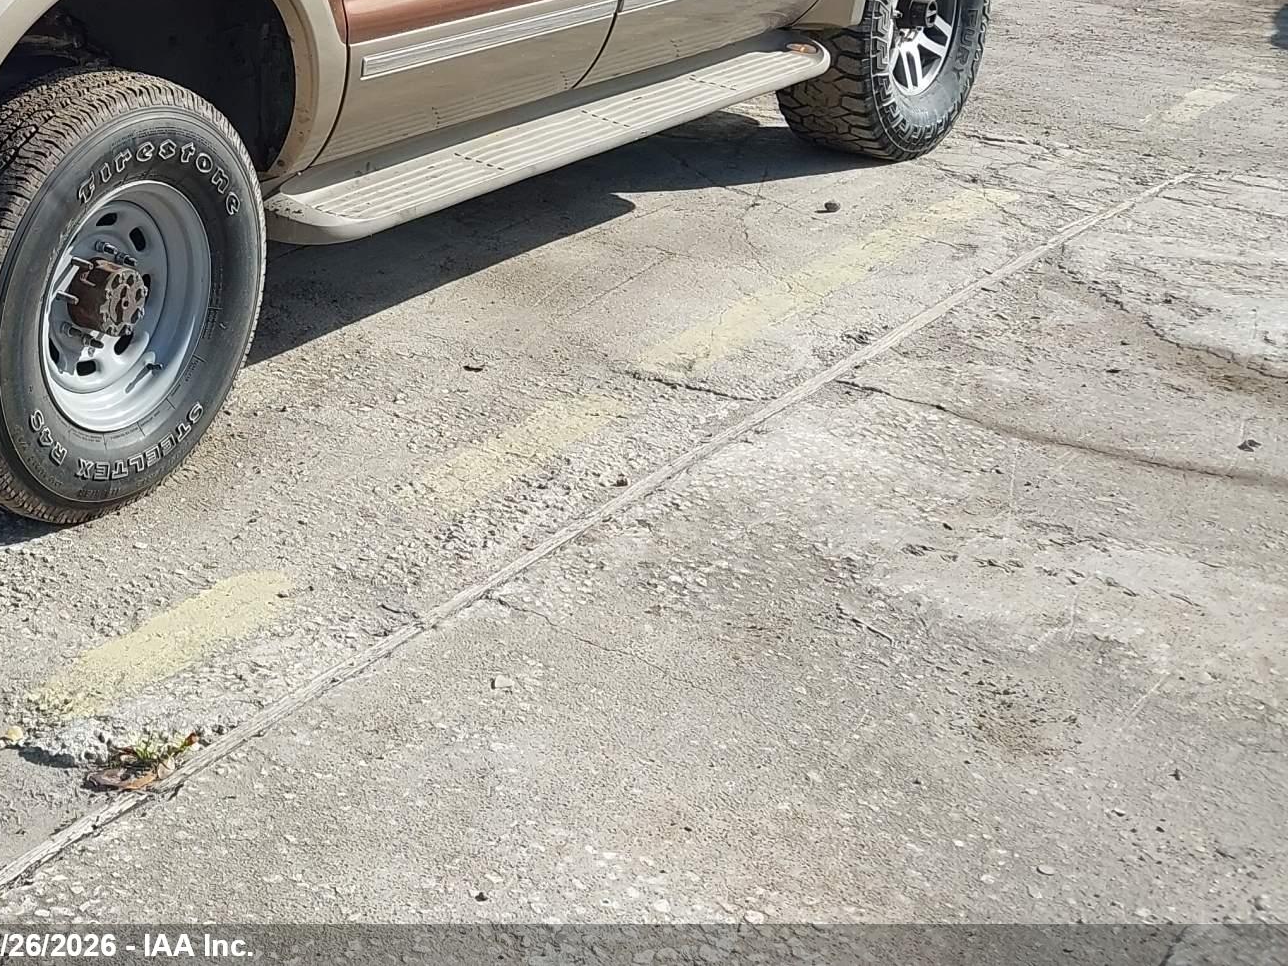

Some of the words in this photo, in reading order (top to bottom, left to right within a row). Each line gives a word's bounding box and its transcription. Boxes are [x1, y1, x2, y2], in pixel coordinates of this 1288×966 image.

[78, 138, 241, 216] Firestone
[29, 409, 68, 466] R4S
[75, 401, 204, 480] STEELTEX
